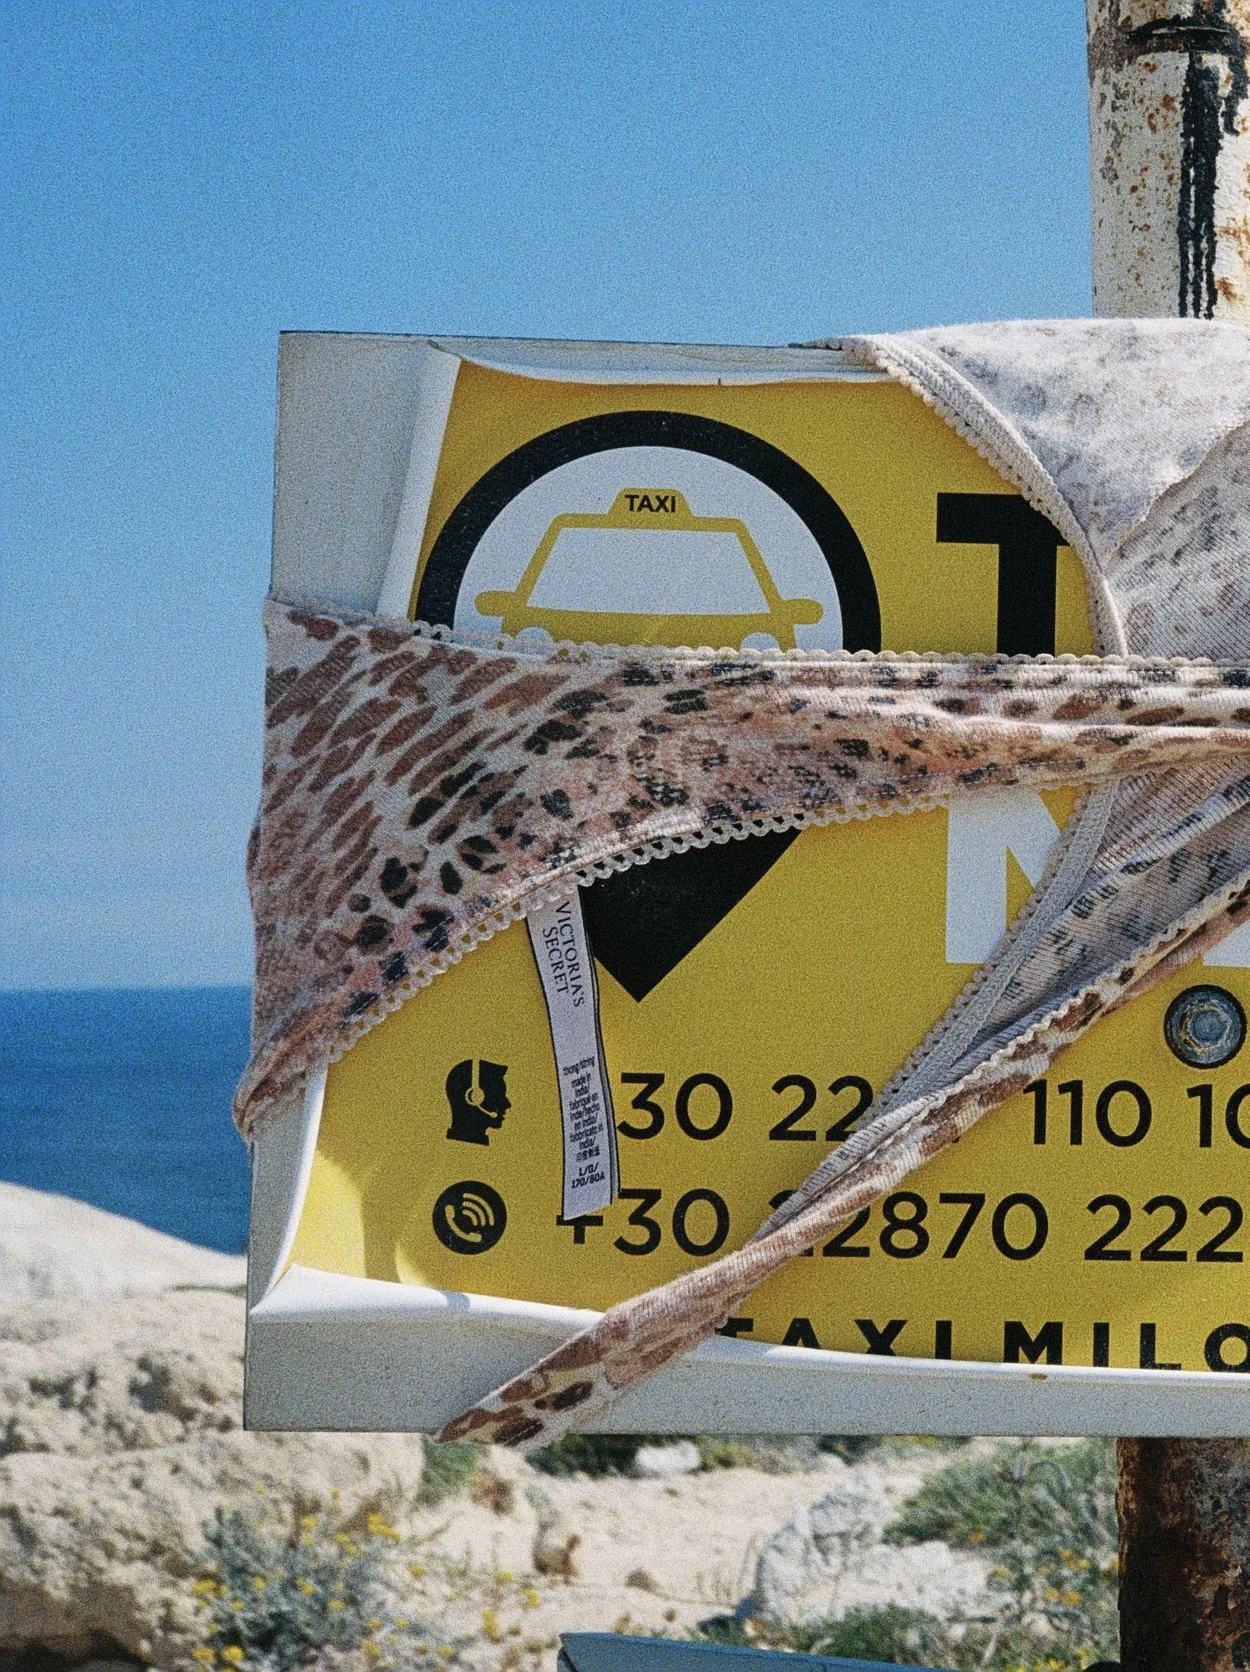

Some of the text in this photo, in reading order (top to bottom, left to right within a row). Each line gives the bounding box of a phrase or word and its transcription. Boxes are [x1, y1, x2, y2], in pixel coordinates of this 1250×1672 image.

[624, 494, 676, 513] TAXI
[542, 926, 569, 994] SECRET
[555, 901, 585, 1008] VICTORIA'S
[1023, 1079, 1152, 1147] 110
[571, 1171, 605, 1189] 170/80A
[556, 1188, 730, 1256] +30
[768, 1189, 1048, 1260] 2870
